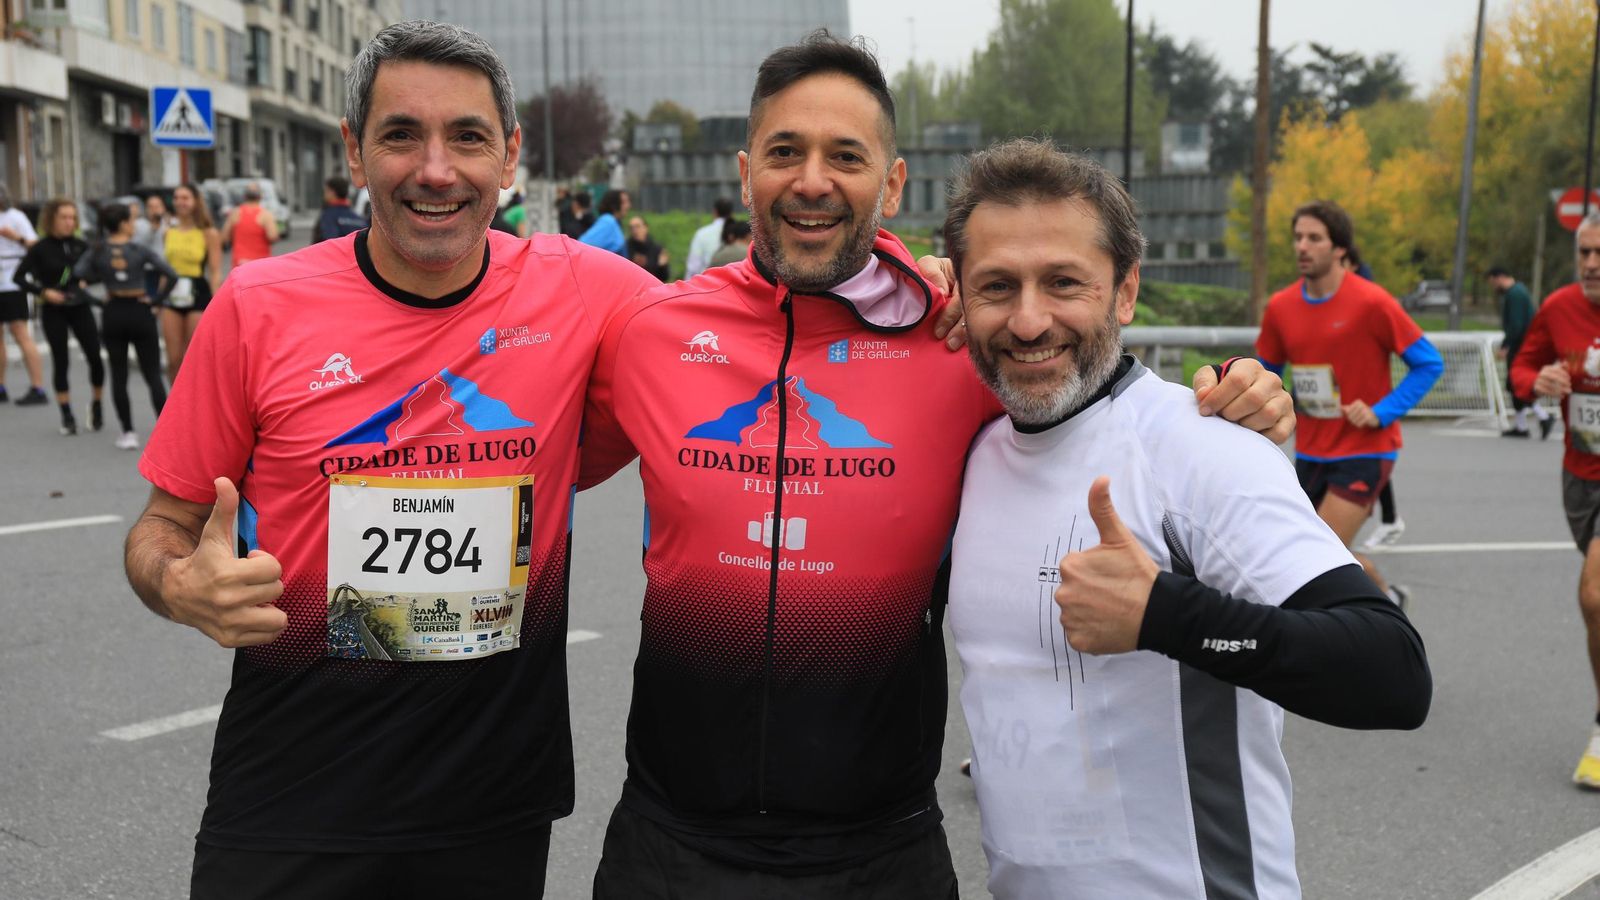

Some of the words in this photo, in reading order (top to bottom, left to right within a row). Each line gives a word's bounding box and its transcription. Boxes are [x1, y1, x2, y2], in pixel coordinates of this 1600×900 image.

[499, 326, 529, 338] XUNTA
[499, 339, 512, 348] DE
[513, 332, 551, 346] GALICIA
[852, 340, 888, 350] XUNTA
[680, 352, 730, 364] austral
[852, 350, 865, 360] DE
[867, 349, 910, 360] GALICIA
[319, 446, 418, 478] CIDADE
[425, 444, 460, 464] DE
[468, 436, 536, 462] LUGO
[678, 447, 771, 475] CIDADE
[781, 456, 816, 477] DE
[823, 457, 896, 478] LUGO
[743, 478, 824, 495] FLUVIAL
[393, 496, 454, 513] BENJAMÍN
[361, 526, 482, 575] 2784
[718, 551, 772, 571] Concello
[778, 558, 796, 571] de
[801, 560, 835, 574] Lugo
[474, 603, 513, 624] XLVIII
[413, 625, 460, 633] OURENSE
